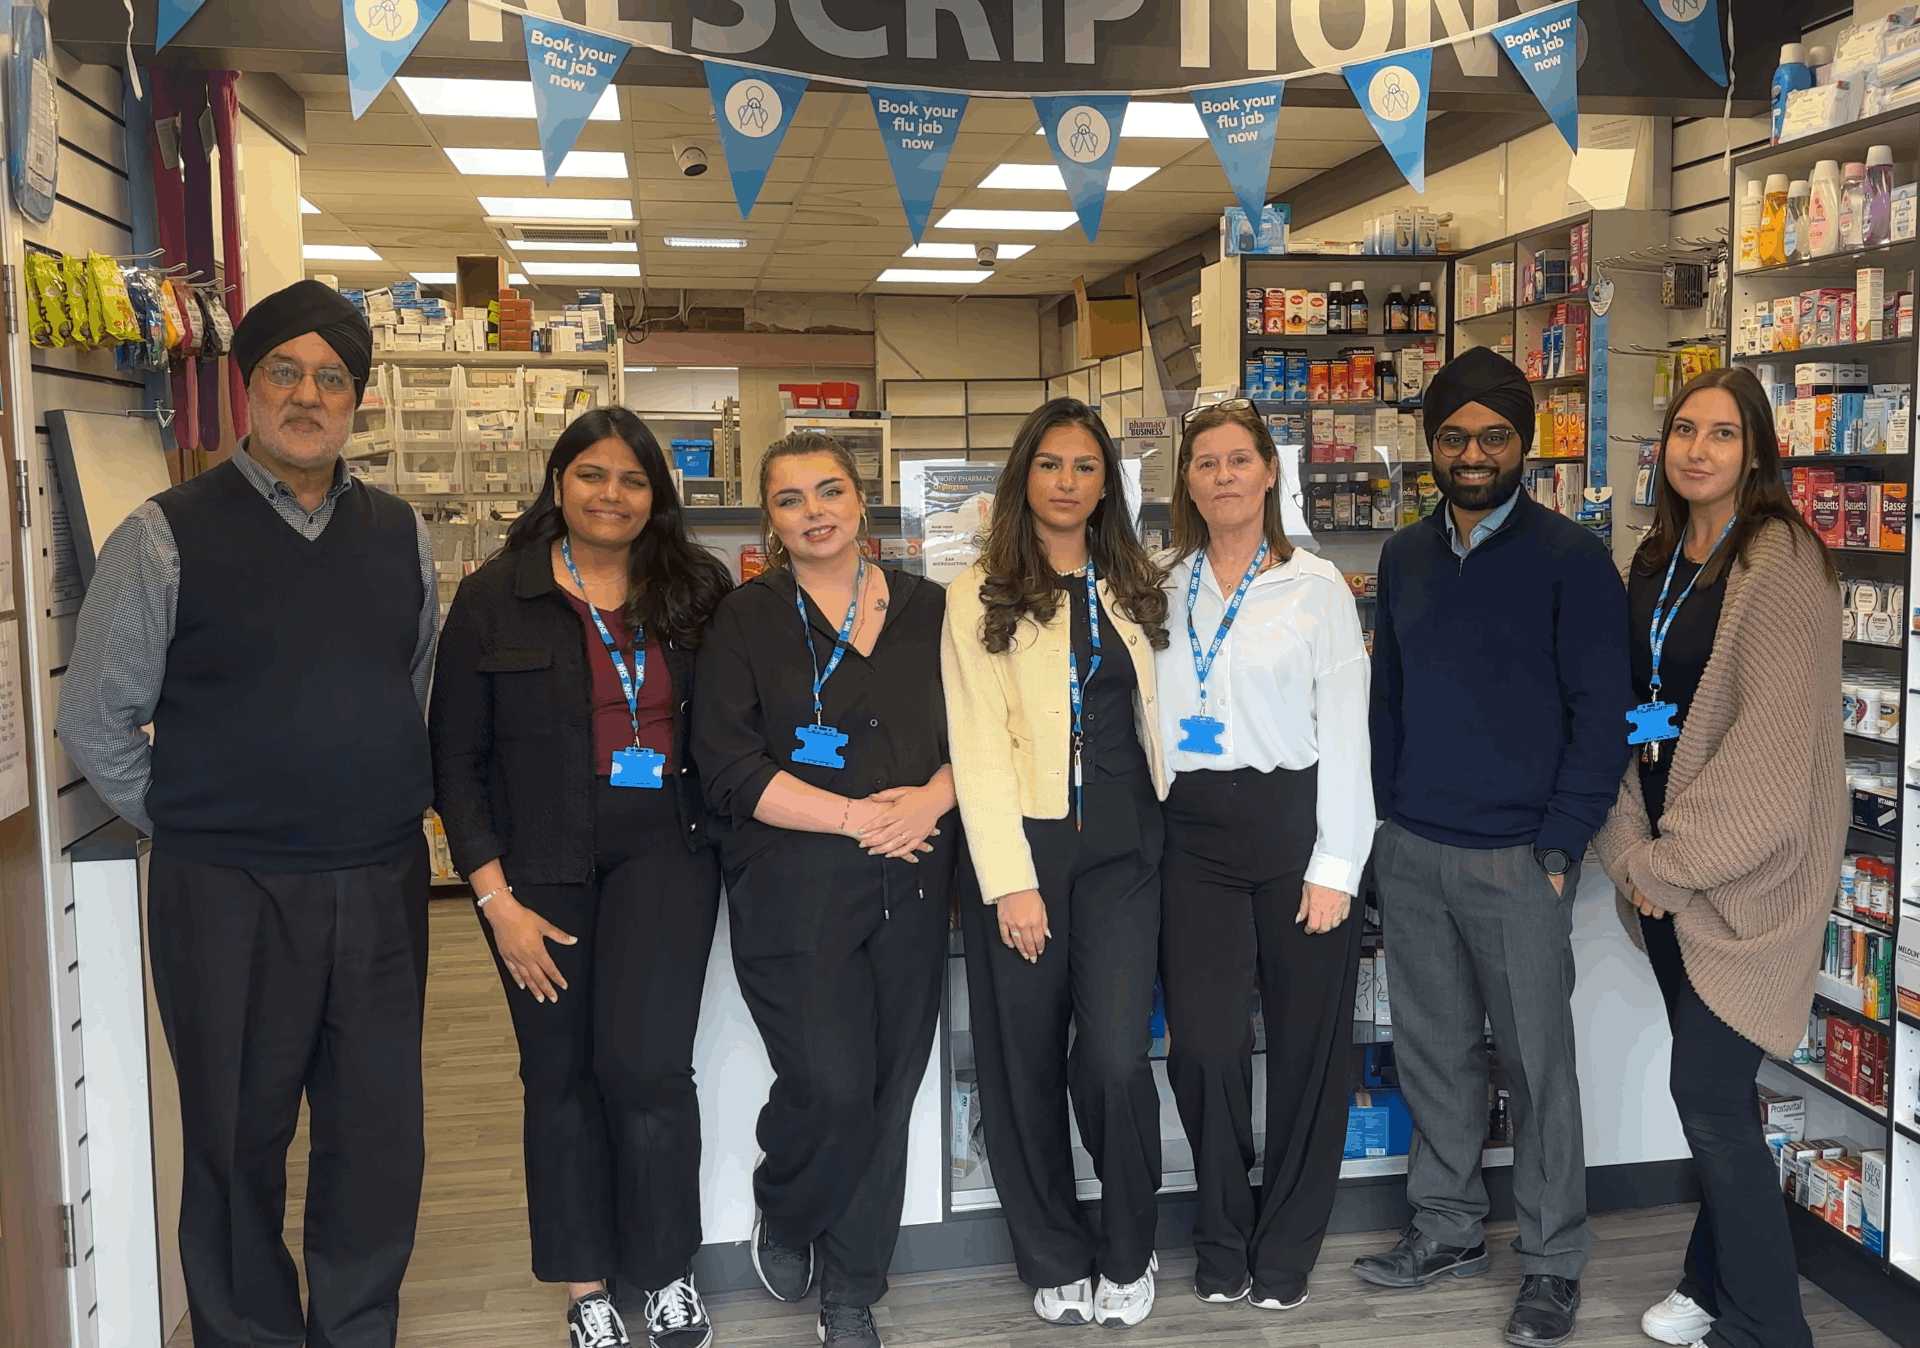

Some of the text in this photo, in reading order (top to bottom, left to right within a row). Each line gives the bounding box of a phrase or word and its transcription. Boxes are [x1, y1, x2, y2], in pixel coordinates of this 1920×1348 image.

[1504, 17, 1572, 49] Book your
[530, 29, 617, 64] Book your
[1521, 35, 1564, 59] flu jab
[543, 51, 597, 77] flu jab
[1534, 54, 1561, 72] now
[549, 73, 586, 91] now
[878, 98, 958, 120] Book your
[1201, 94, 1276, 114] Book your
[892, 116, 943, 137] flu jab
[1216, 110, 1265, 130] flu jab
[901, 137, 935, 150] now
[1227, 130, 1258, 144] now
[1129, 420, 1166, 430] pharmacy
[1131, 428, 1163, 436] BUSINESS
[1812, 500, 1838, 511] Bassetts
[1845, 500, 1866, 511] Bassetts
[1256, 550, 1265, 564] NHS
[1087, 568, 1095, 582] NHS
[1247, 564, 1257, 578] NHS
[1190, 577, 1199, 590] NHS
[1239, 577, 1250, 592] NHS
[1187, 593, 1196, 608] NHS
[1231, 593, 1242, 609] NHS
[597, 619, 609, 635] NHS
[843, 620, 853, 632] NHS
[1091, 622, 1099, 638] NHS
[1211, 638, 1222, 654] NHS
[616, 663, 629, 680] NHS
[623, 683, 633, 700] NHS
[1071, 687, 1080, 703] NHS
[1897, 944, 1919, 959] MELOLIN
[1770, 1101, 1803, 1114] Prostavital
[1864, 1161, 1881, 1178] ultra
[1864, 1171, 1880, 1189] DEX
